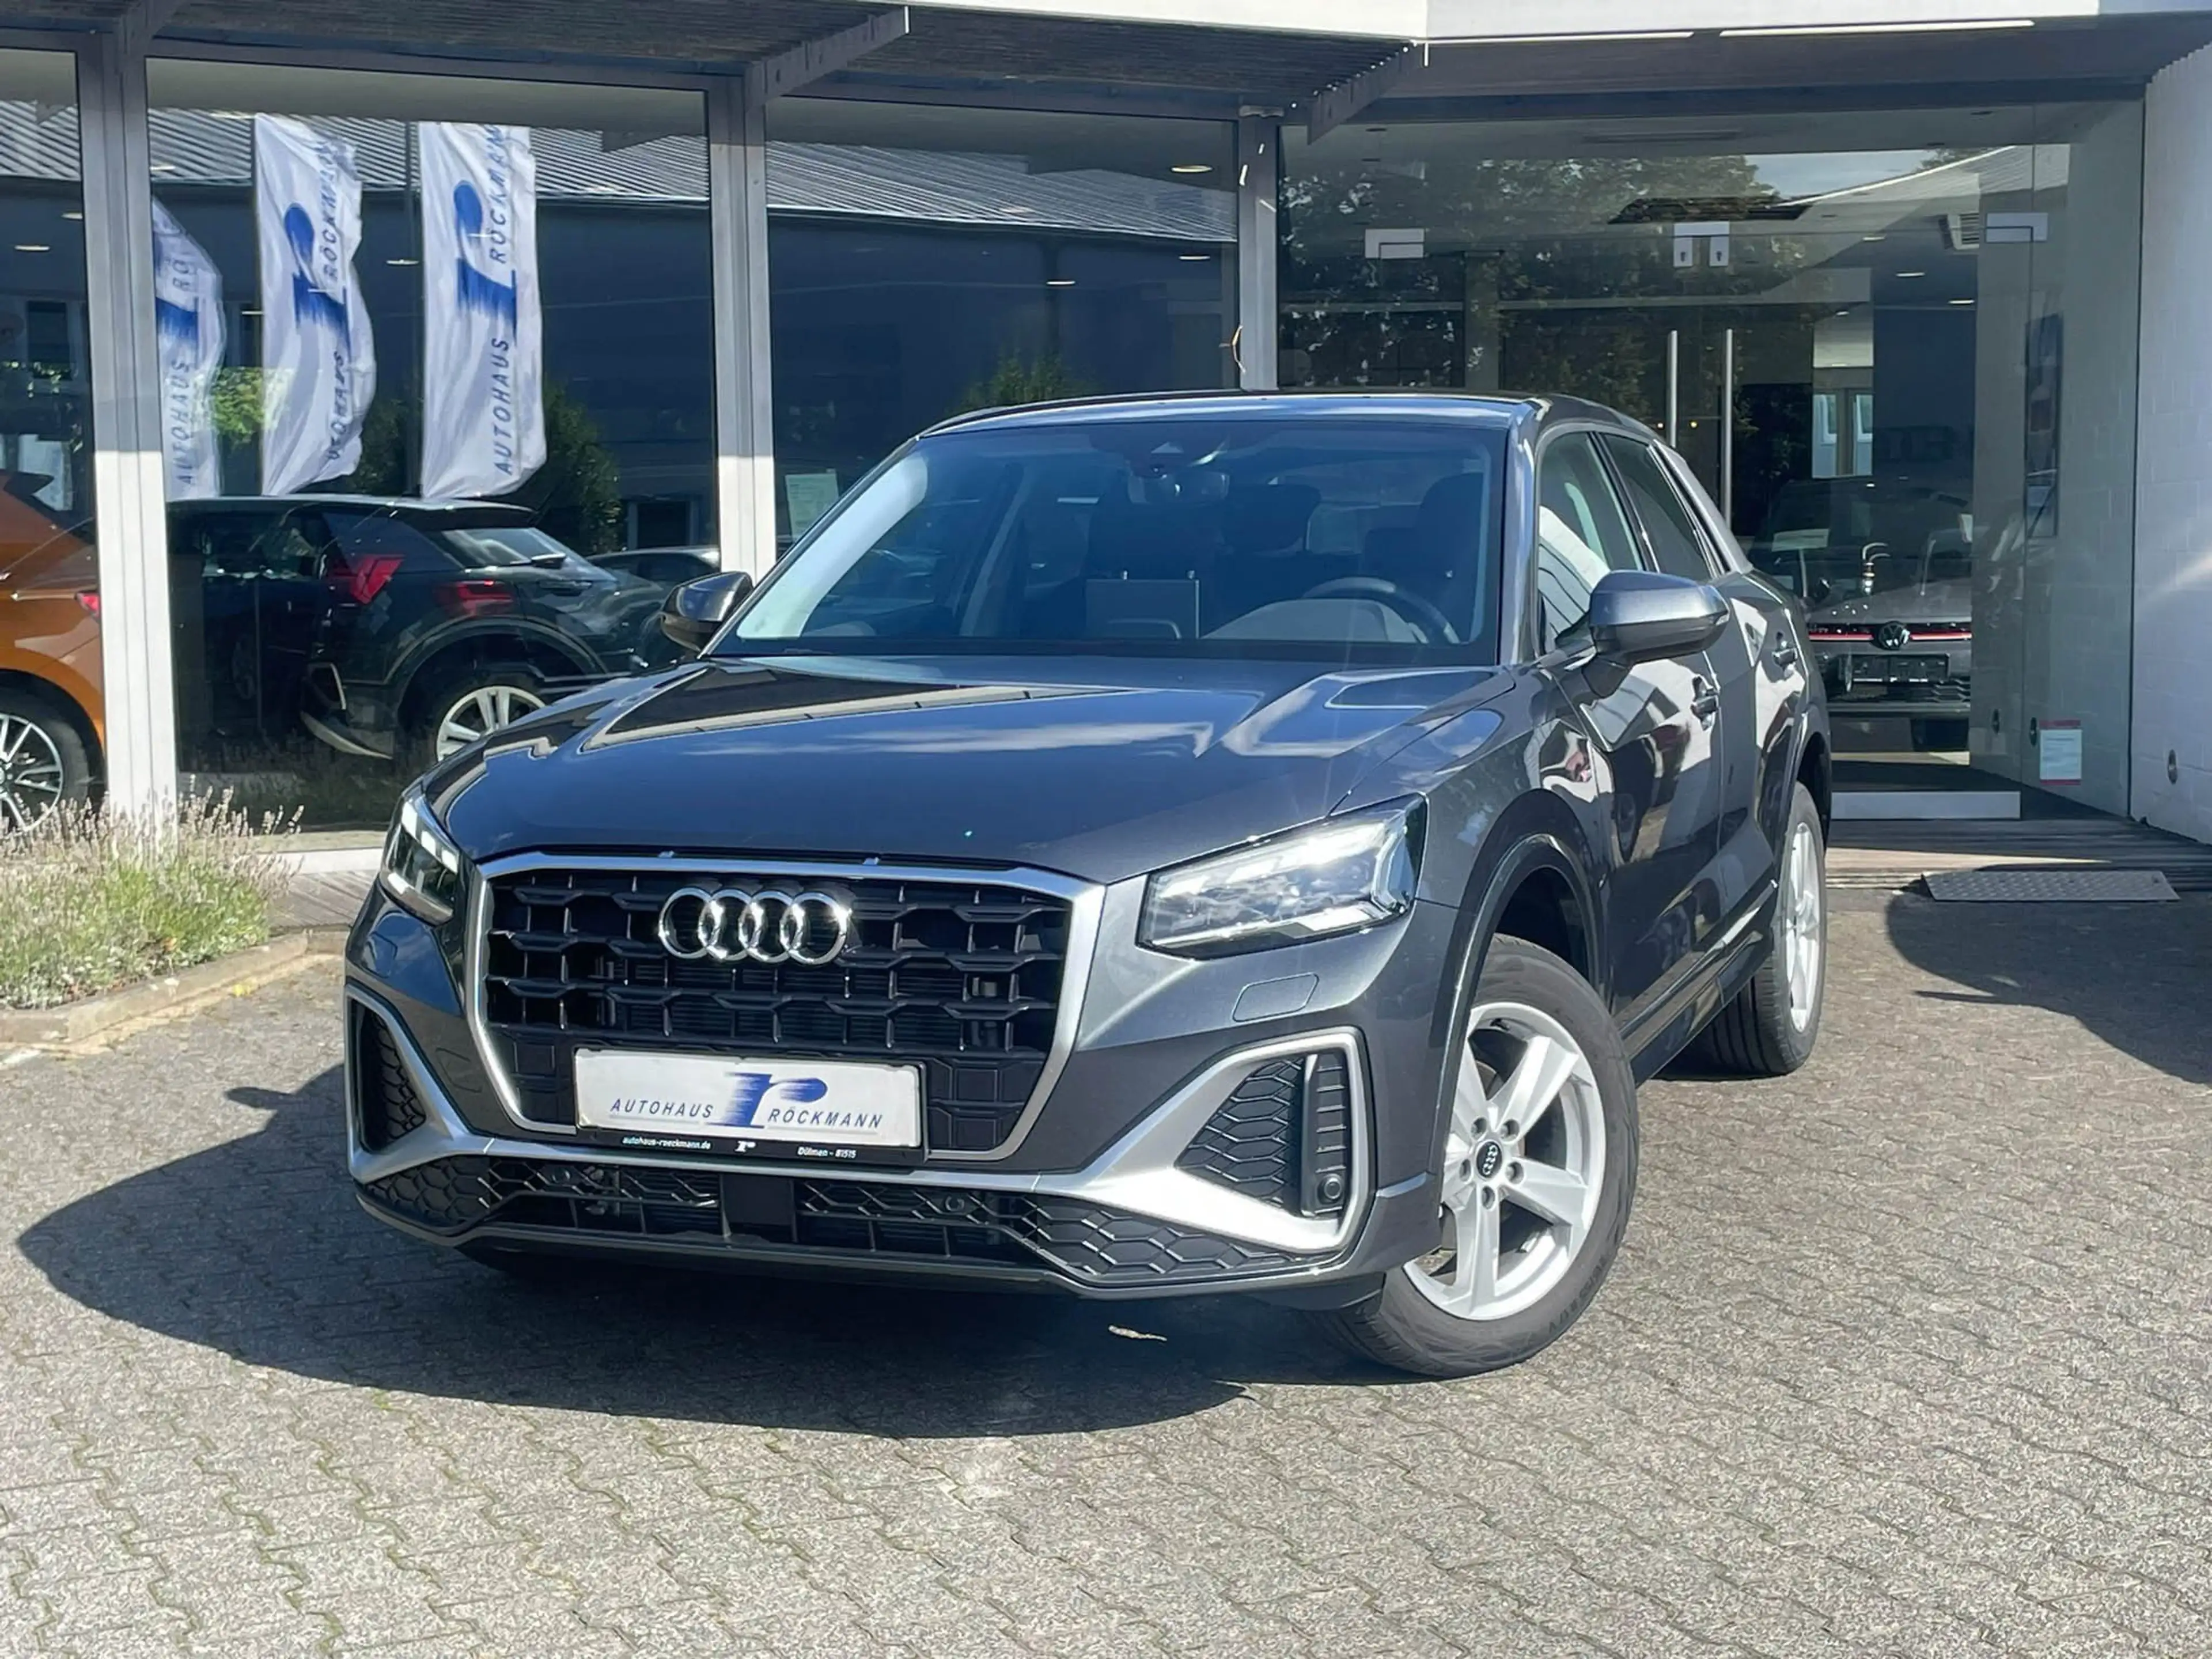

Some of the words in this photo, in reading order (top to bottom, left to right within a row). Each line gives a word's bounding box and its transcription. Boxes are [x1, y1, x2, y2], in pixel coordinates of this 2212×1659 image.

[171, 358, 195, 485] AUTOHAUS
[328, 350, 348, 460] UTOHAUS
[490, 338, 514, 476] AUTOHAUS
[609, 1098, 714, 1119] AUTOHAUS
[767, 1105, 883, 1128] RÖCKMANN
[622, 1137, 711, 1150] autohaus-roeckmann.de
